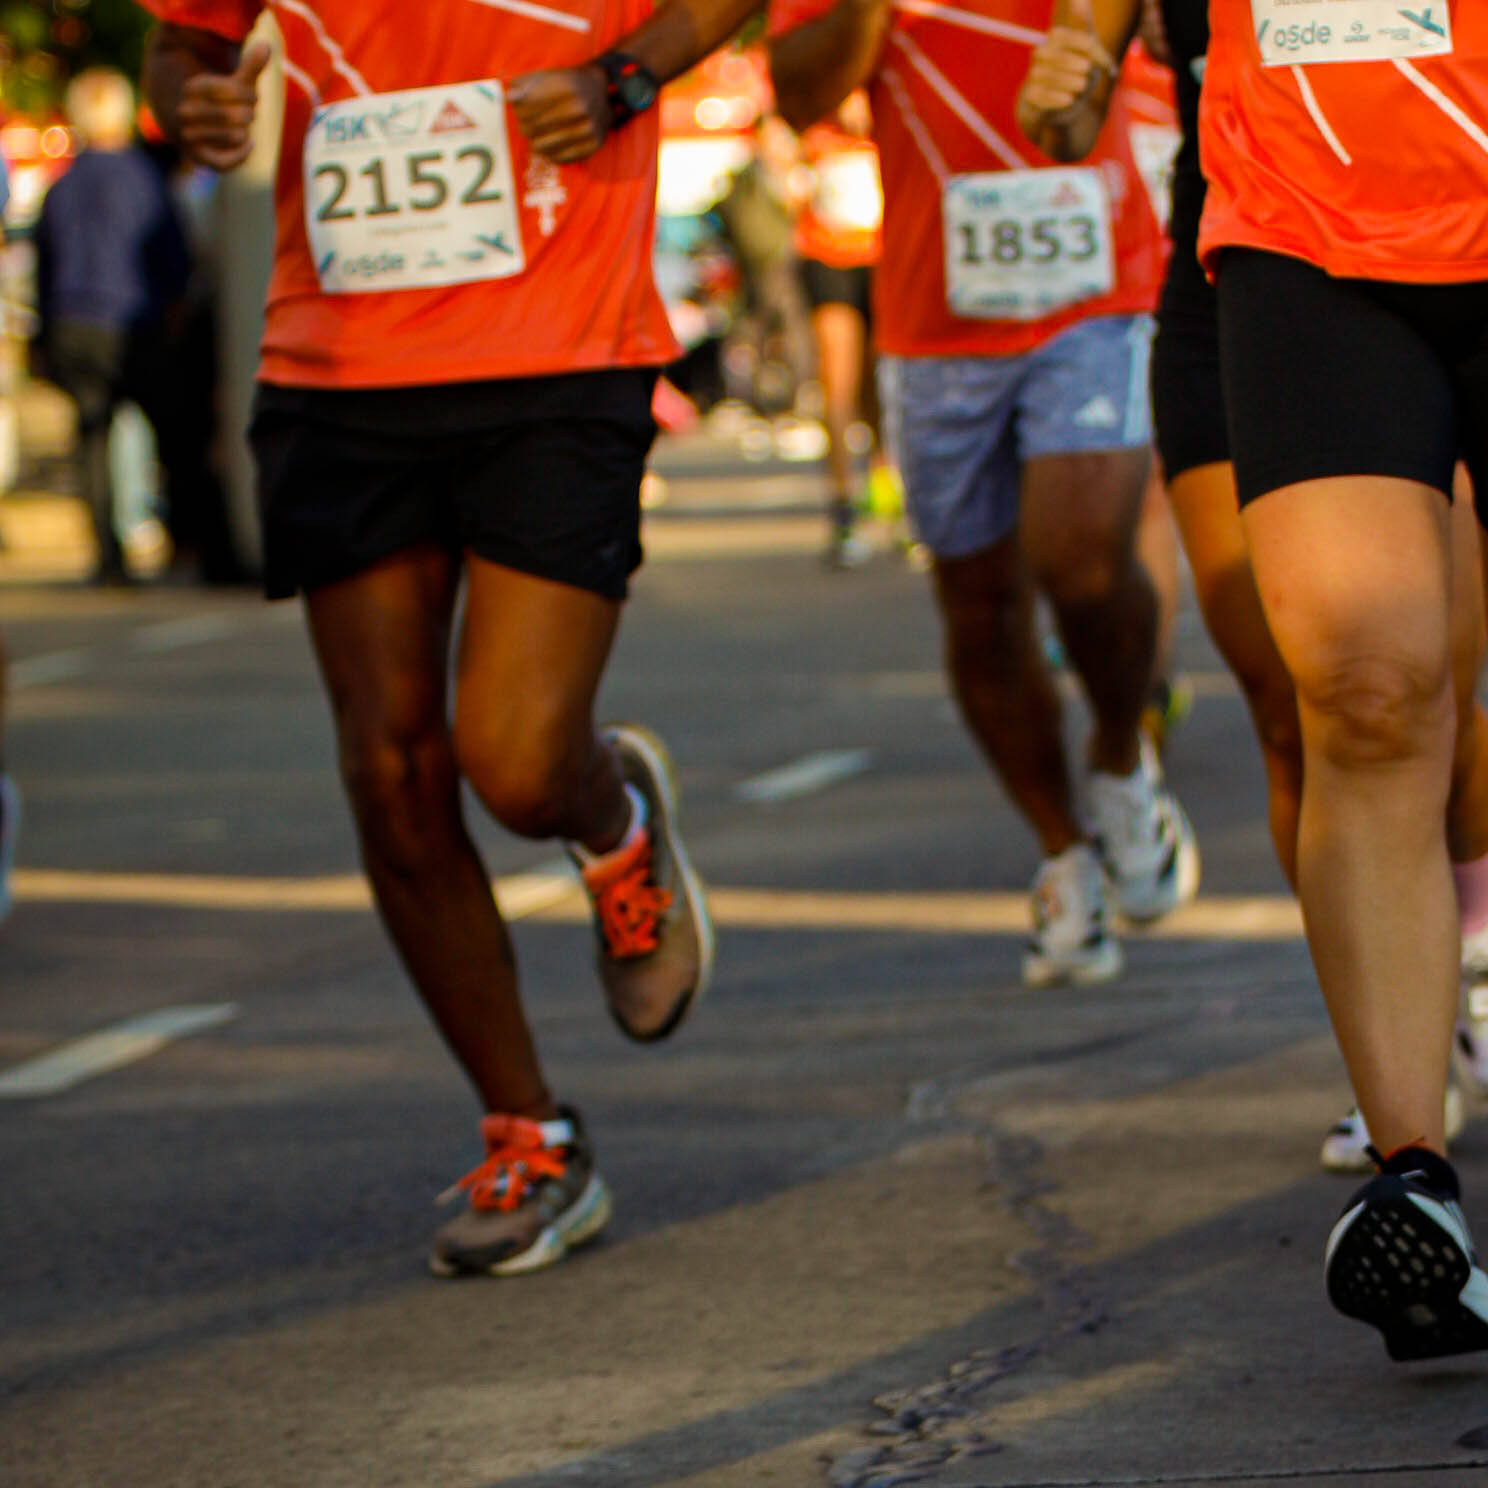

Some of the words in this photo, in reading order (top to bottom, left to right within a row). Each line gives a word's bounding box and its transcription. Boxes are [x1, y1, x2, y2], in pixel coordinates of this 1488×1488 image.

[1274, 20, 1332, 50] osde
[325, 112, 370, 143] 15K
[313, 143, 503, 224] 2152
[959, 215, 1099, 265] 1853
